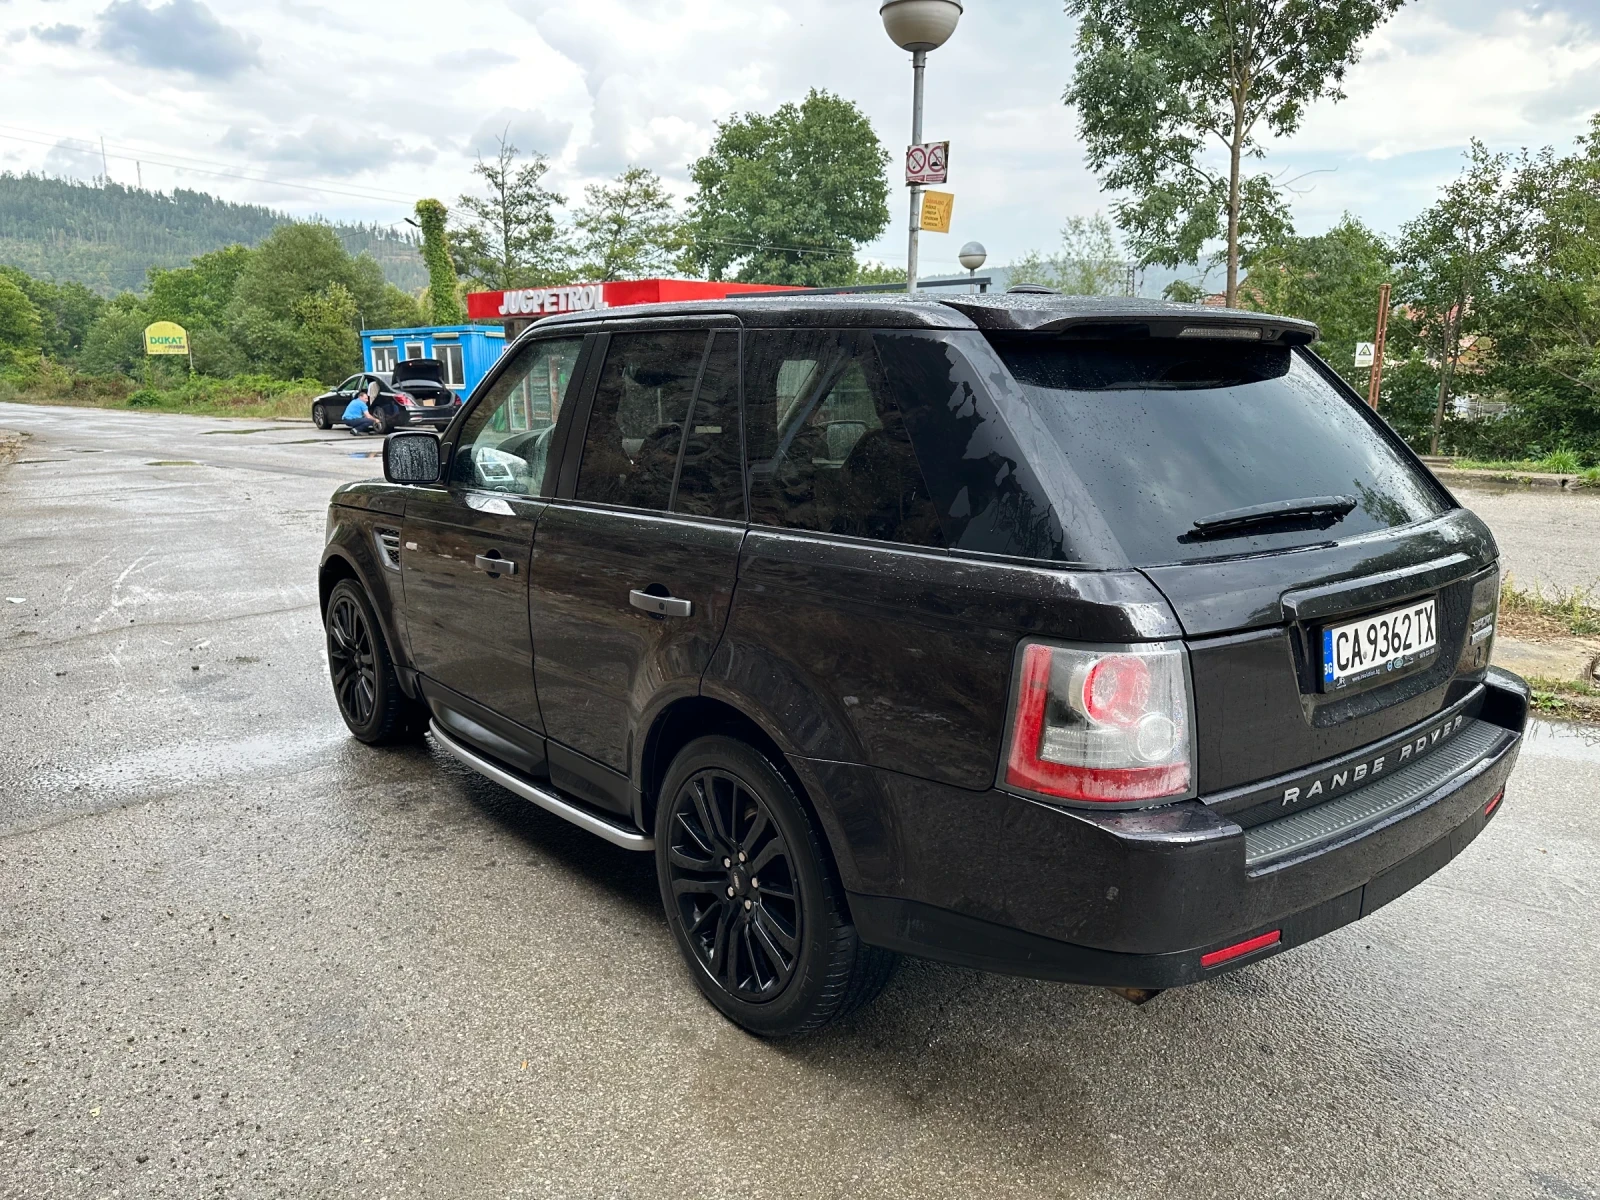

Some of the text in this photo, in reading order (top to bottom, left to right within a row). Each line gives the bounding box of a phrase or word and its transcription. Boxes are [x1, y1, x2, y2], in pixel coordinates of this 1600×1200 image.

[498, 284, 609, 315] JUGPETROL
[150, 336, 183, 345] DUKAT
[1282, 715, 1463, 806] RANGE ROVER
